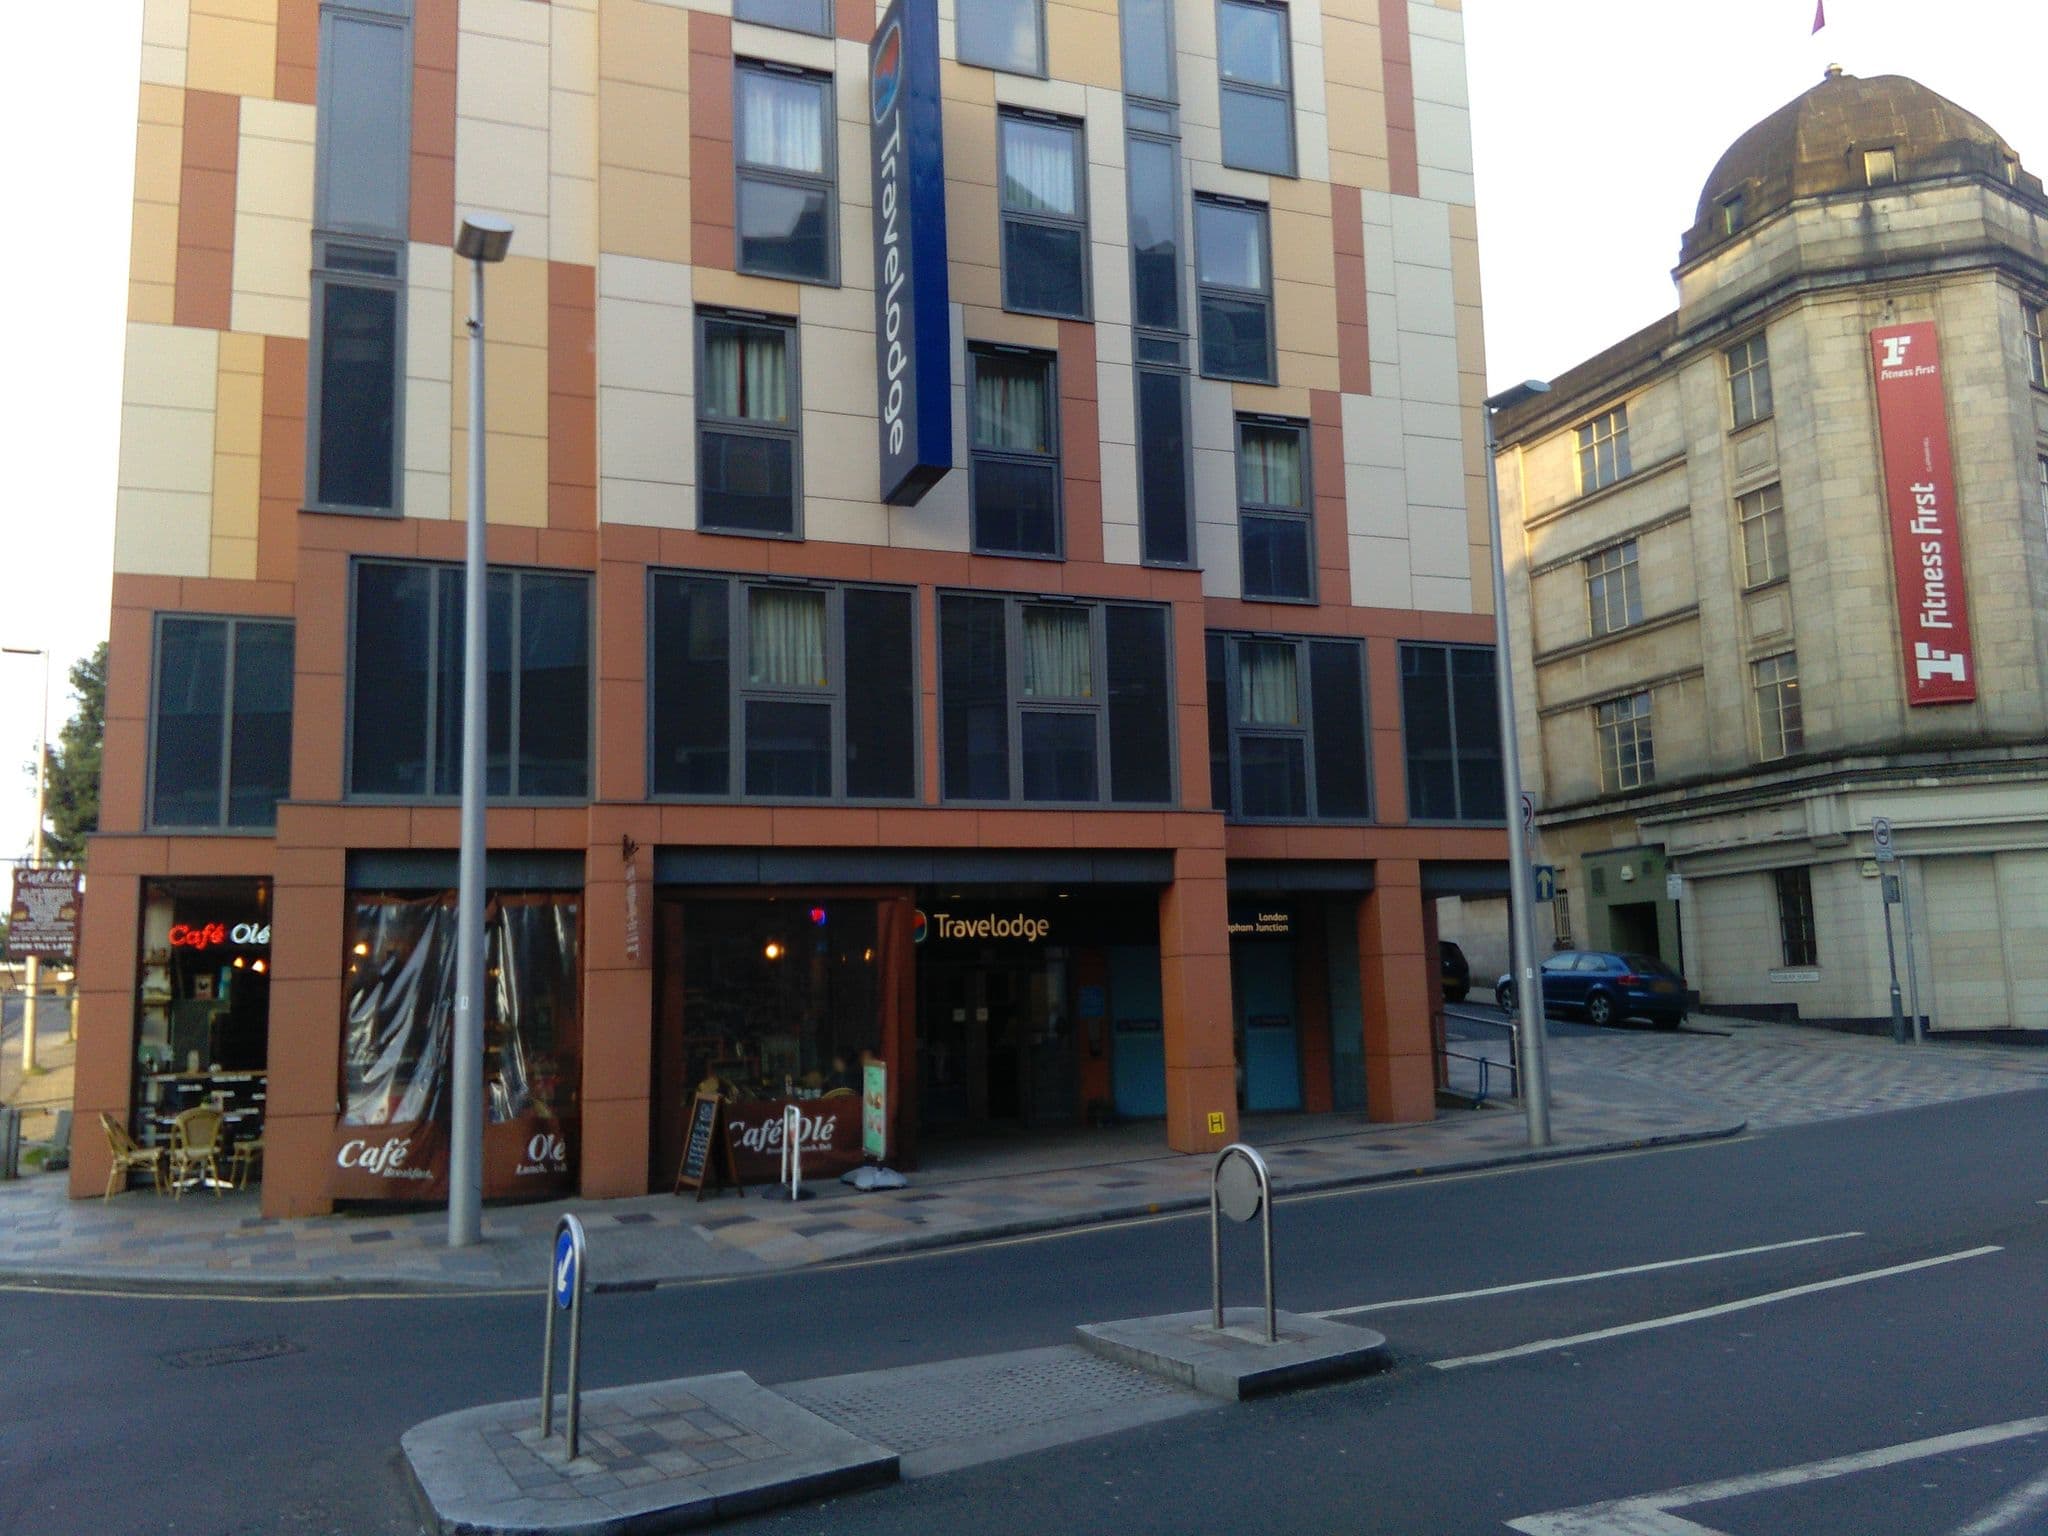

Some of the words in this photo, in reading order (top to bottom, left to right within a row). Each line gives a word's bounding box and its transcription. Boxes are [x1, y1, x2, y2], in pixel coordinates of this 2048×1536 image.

[881, 108, 906, 456] Travelodge
[933, 913, 1050, 942] Travelodge
[1255, 922, 1289, 932] Junction
[1258, 912, 1288, 922] London
[168, 923, 225, 950] Café
[231, 922, 271, 944] Olé
[337, 1138, 412, 1174] Café
[528, 1134, 566, 1161] Olé
